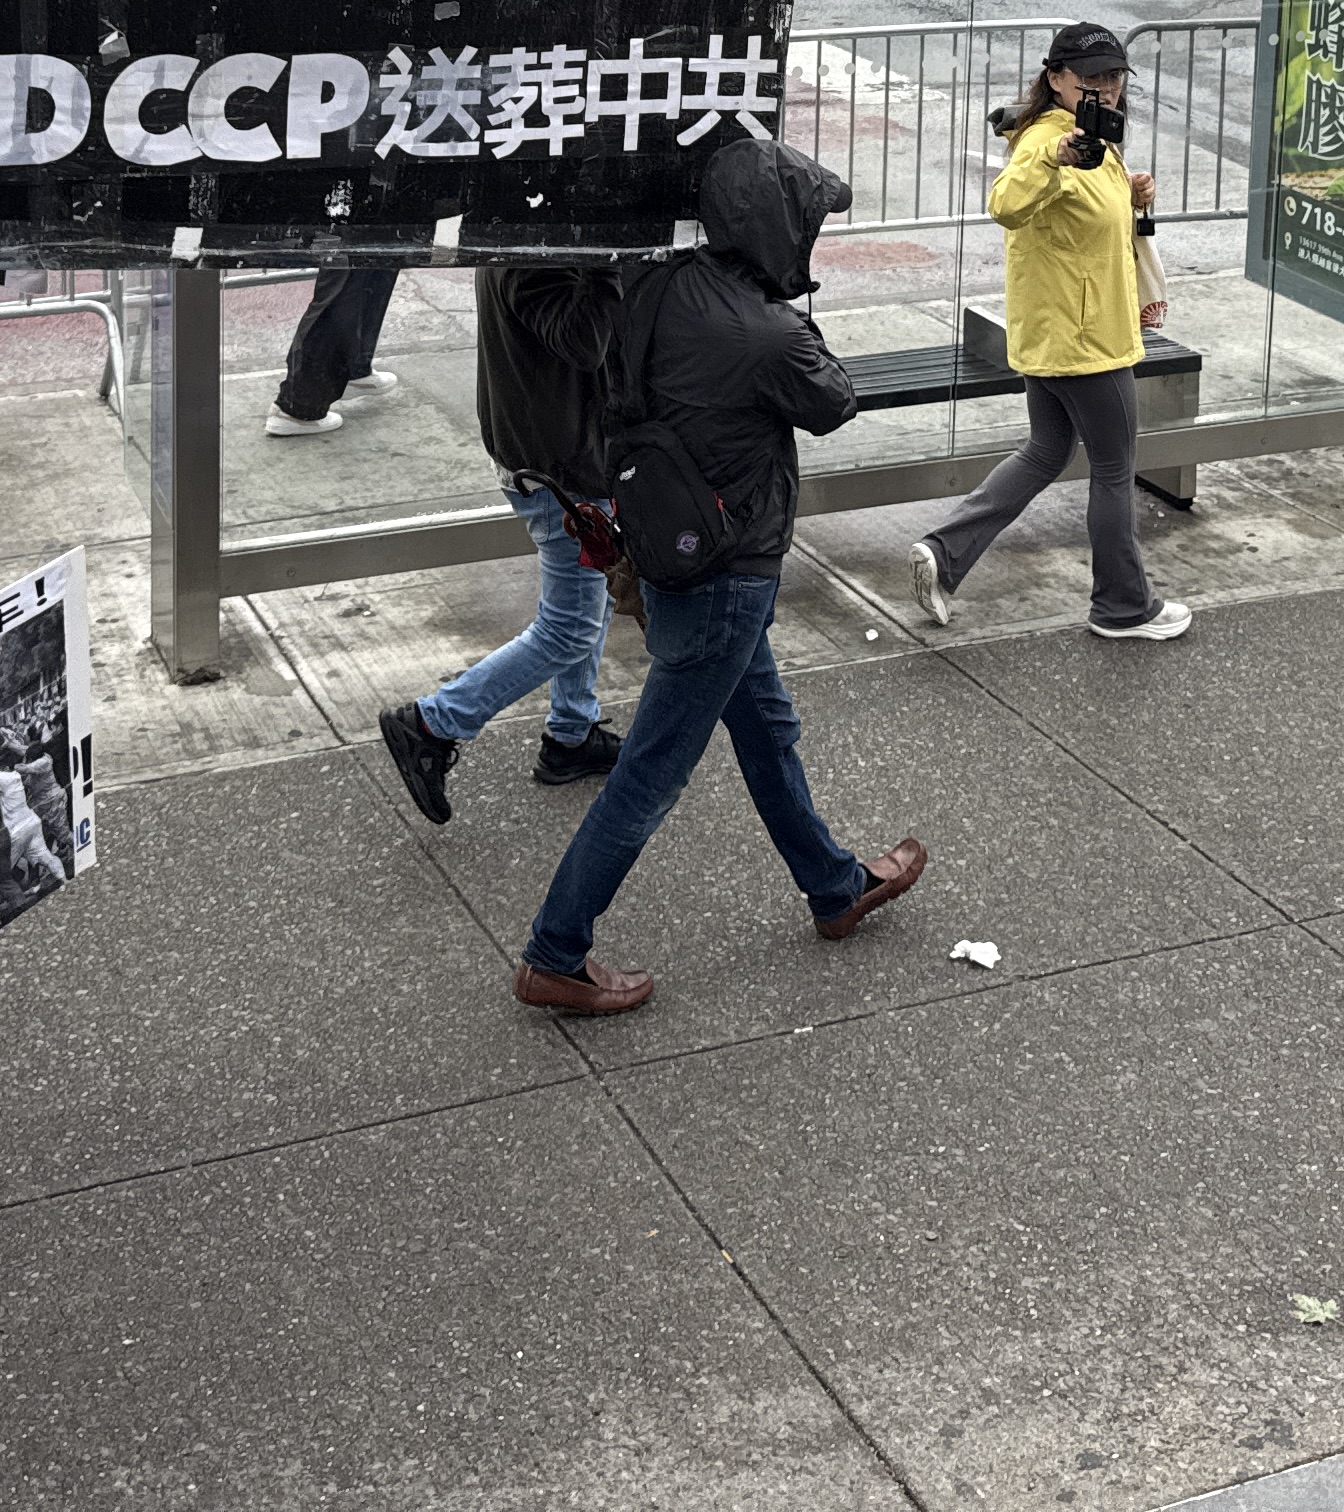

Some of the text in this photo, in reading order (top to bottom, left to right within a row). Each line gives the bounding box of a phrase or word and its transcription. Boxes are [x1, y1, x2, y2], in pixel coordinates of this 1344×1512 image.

[103, 50, 371, 166] CCP
[374, 34, 779, 161] 送葬中共
